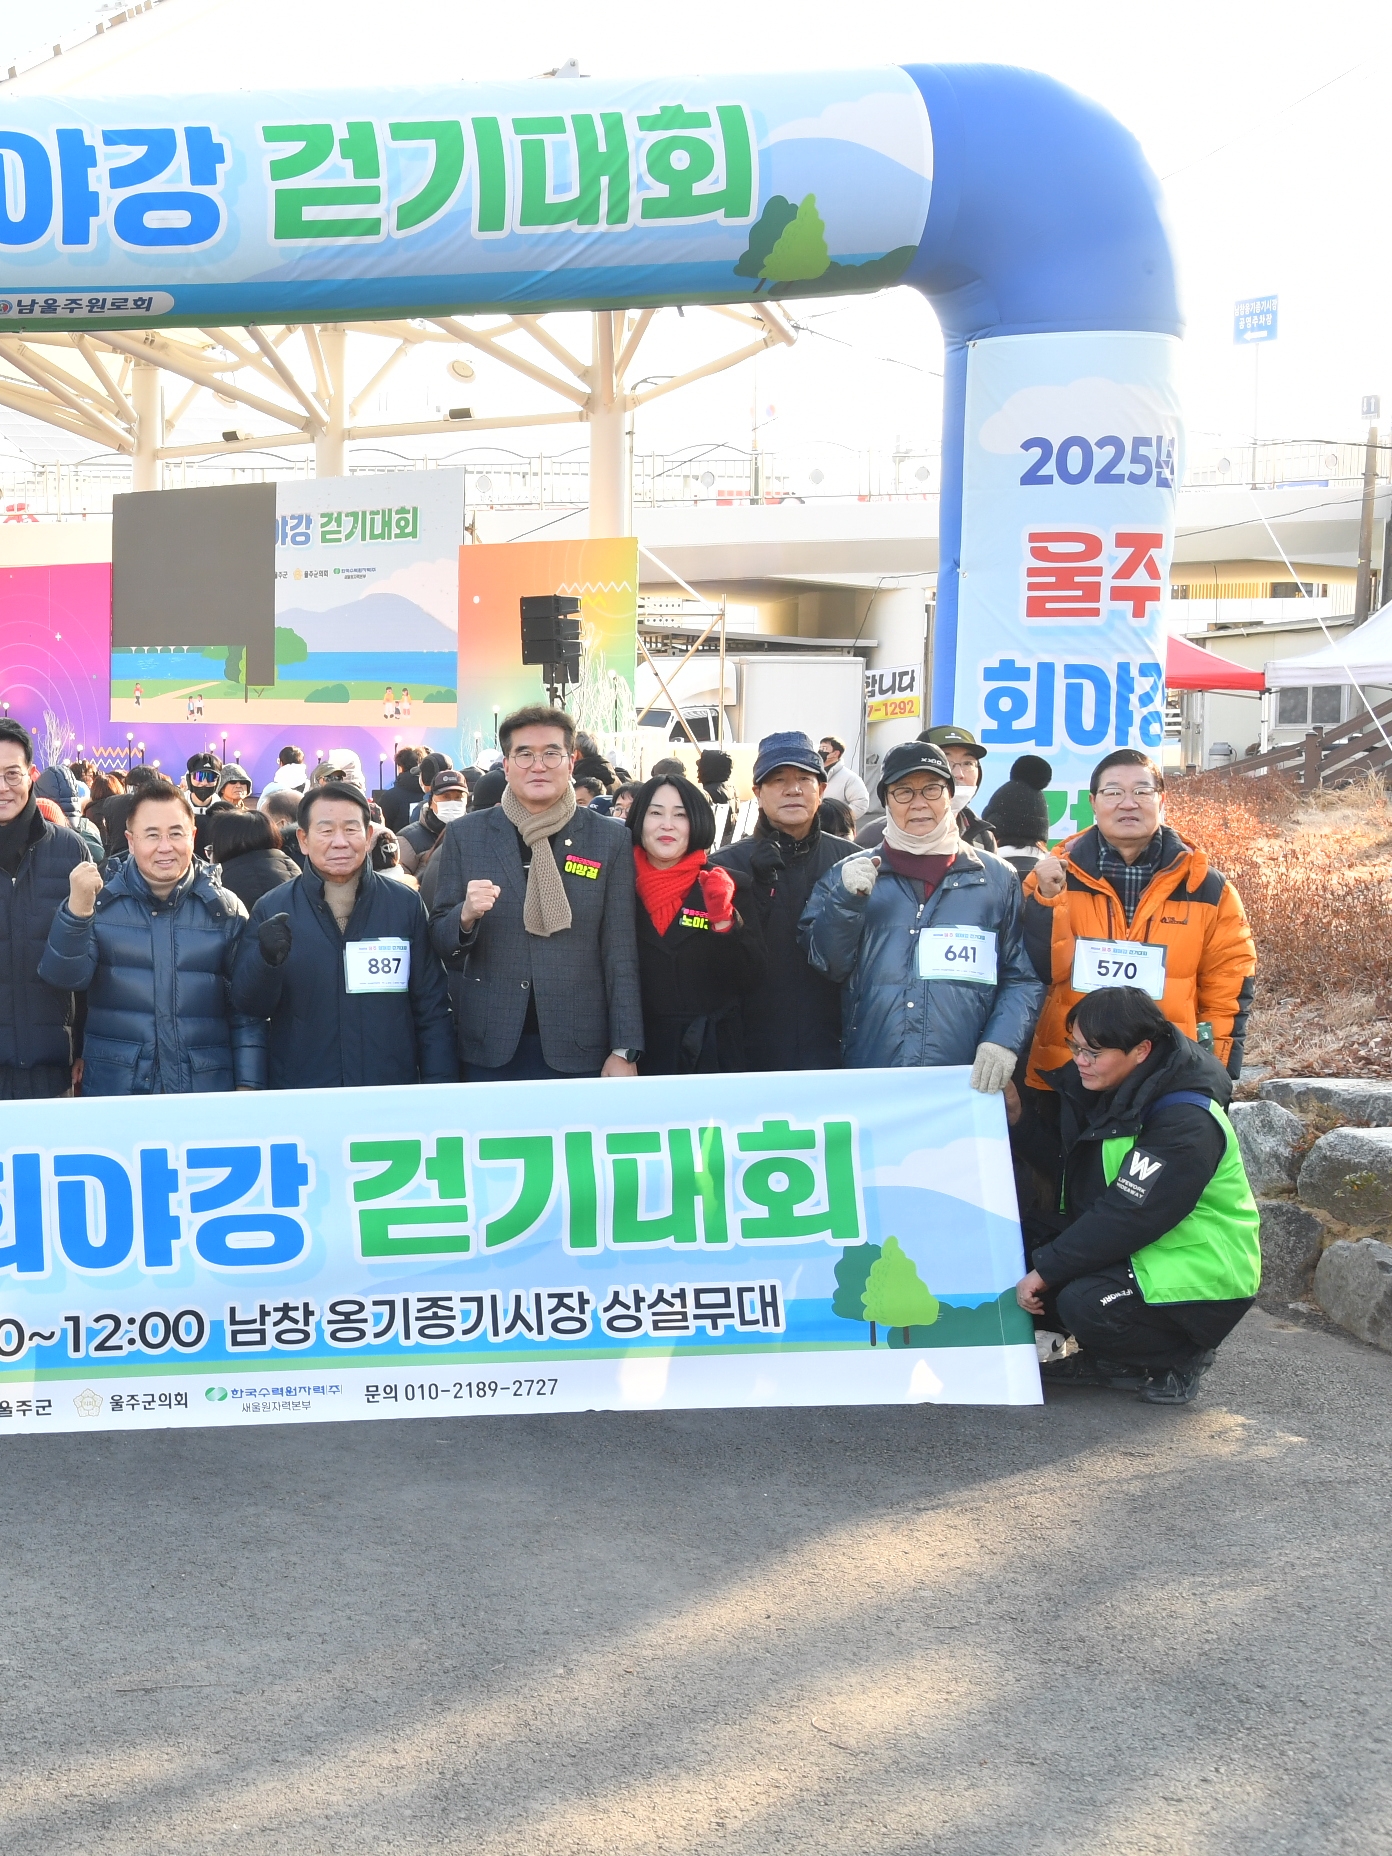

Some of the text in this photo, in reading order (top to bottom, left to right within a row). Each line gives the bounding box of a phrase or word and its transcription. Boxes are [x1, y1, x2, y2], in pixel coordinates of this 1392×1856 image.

[264, 104, 753, 239] 걷기대회
[16, 297, 154, 314] 남울주원로회
[1239, 314, 1273, 329] 공영주차장
[1020, 435, 1175, 488] 2025년
[320, 506, 419, 544] 걷기대회
[1026, 531, 1163, 618] 울주
[981, 659, 1164, 747] 회야강
[368, 957, 402, 974] 887
[944, 945, 977, 963] 641
[1097, 959, 1137, 979] 570
[348, 1119, 861, 1257] 걷기대회
[1116, 1182, 1145, 1199] HIDEAWAY
[1117, 1176, 1147, 1195] LIFEWORK
[228, 1302, 316, 1348] 남창
[326, 1288, 590, 1344] 옹기종기시장
[602, 1283, 781, 1334] 상설무대
[109, 1391, 189, 1412] 울주군의회
[364, 1382, 399, 1404] 문의
[404, 1378, 560, 1402] 010-2189-2727
[240, 1400, 312, 1414] 새울원자력본부
